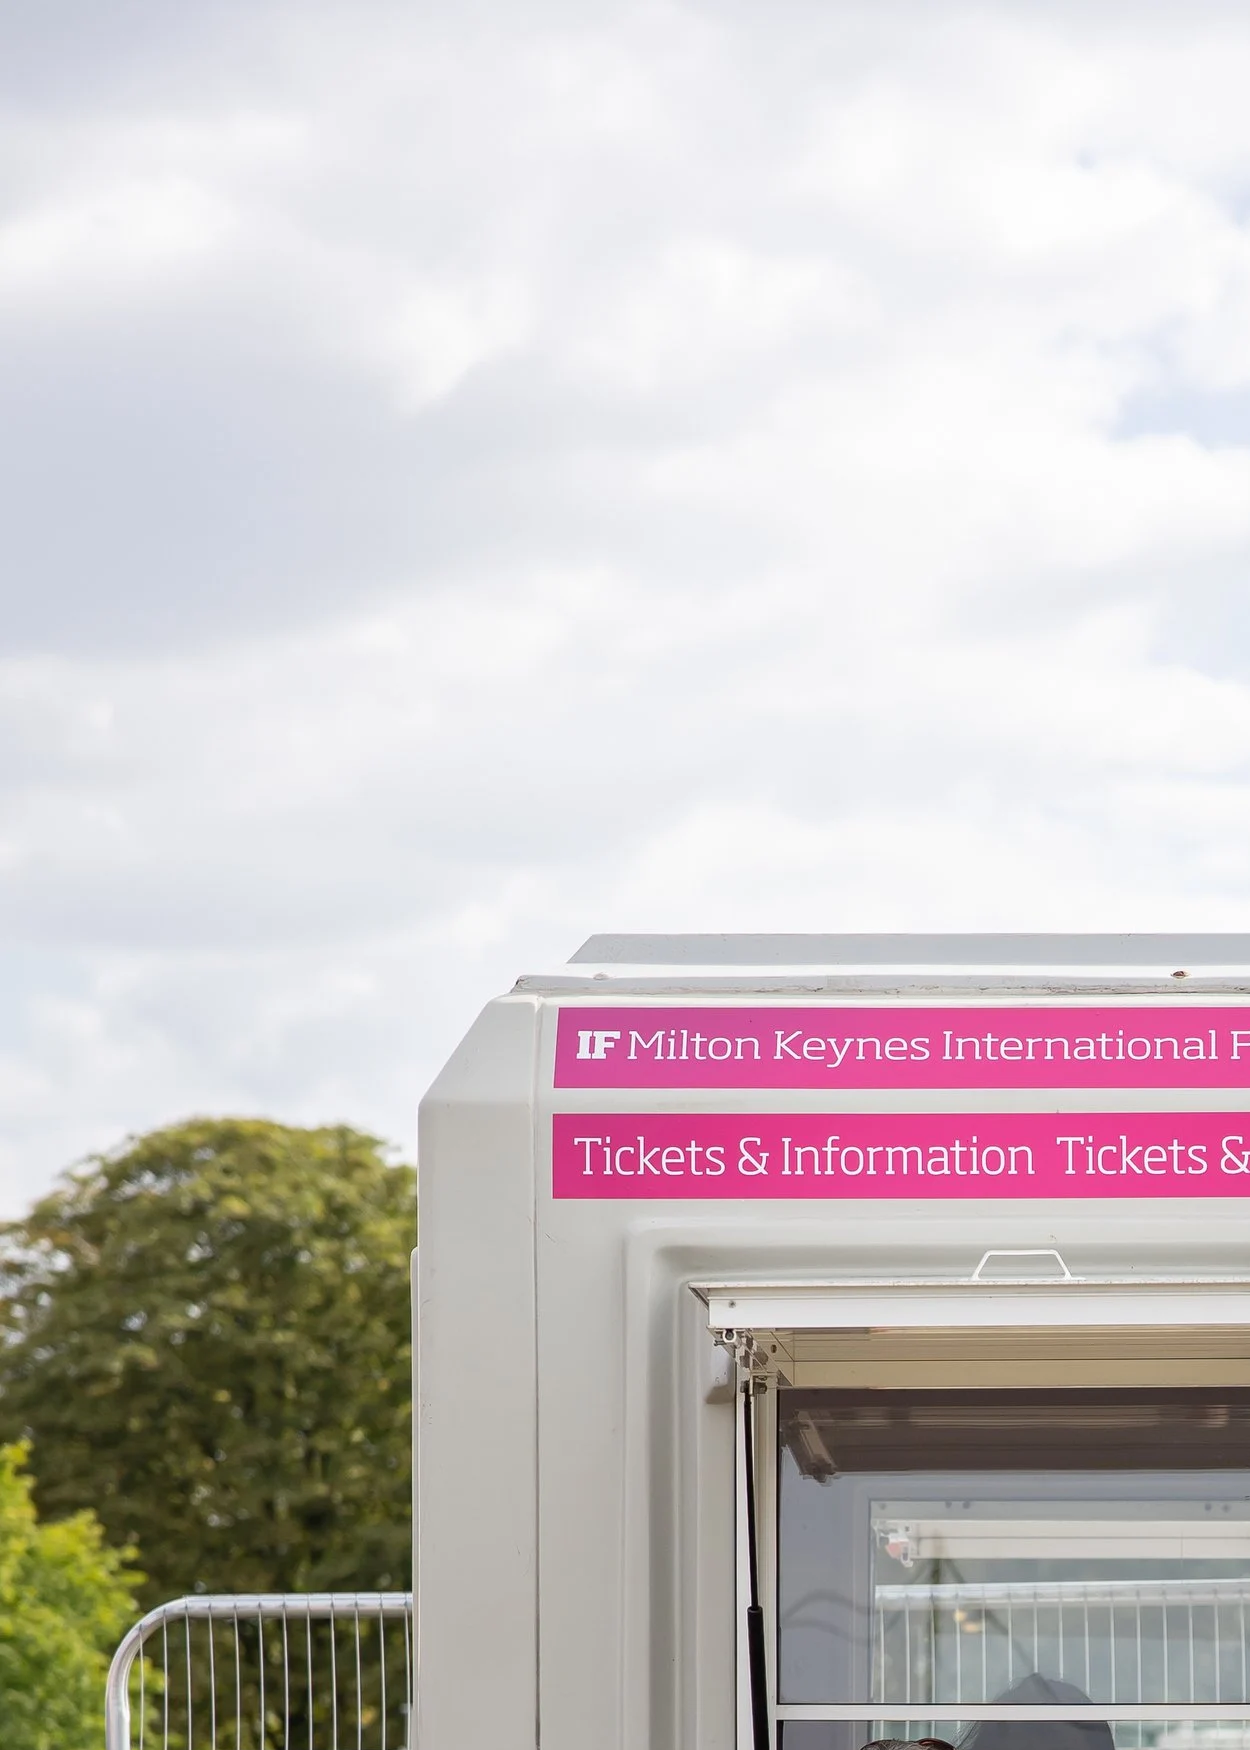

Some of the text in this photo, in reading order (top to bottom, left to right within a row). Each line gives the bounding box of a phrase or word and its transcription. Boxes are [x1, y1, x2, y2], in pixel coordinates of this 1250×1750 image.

[576, 1030, 621, 1060] IF
[627, 1029, 761, 1060] Milton
[774, 1030, 930, 1068] Keynes
[943, 1029, 1219, 1060] International
[573, 1135, 726, 1176] Tickets
[737, 1136, 770, 1176] &
[781, 1135, 1036, 1176] Information
[1056, 1135, 1208, 1175] Tickets
